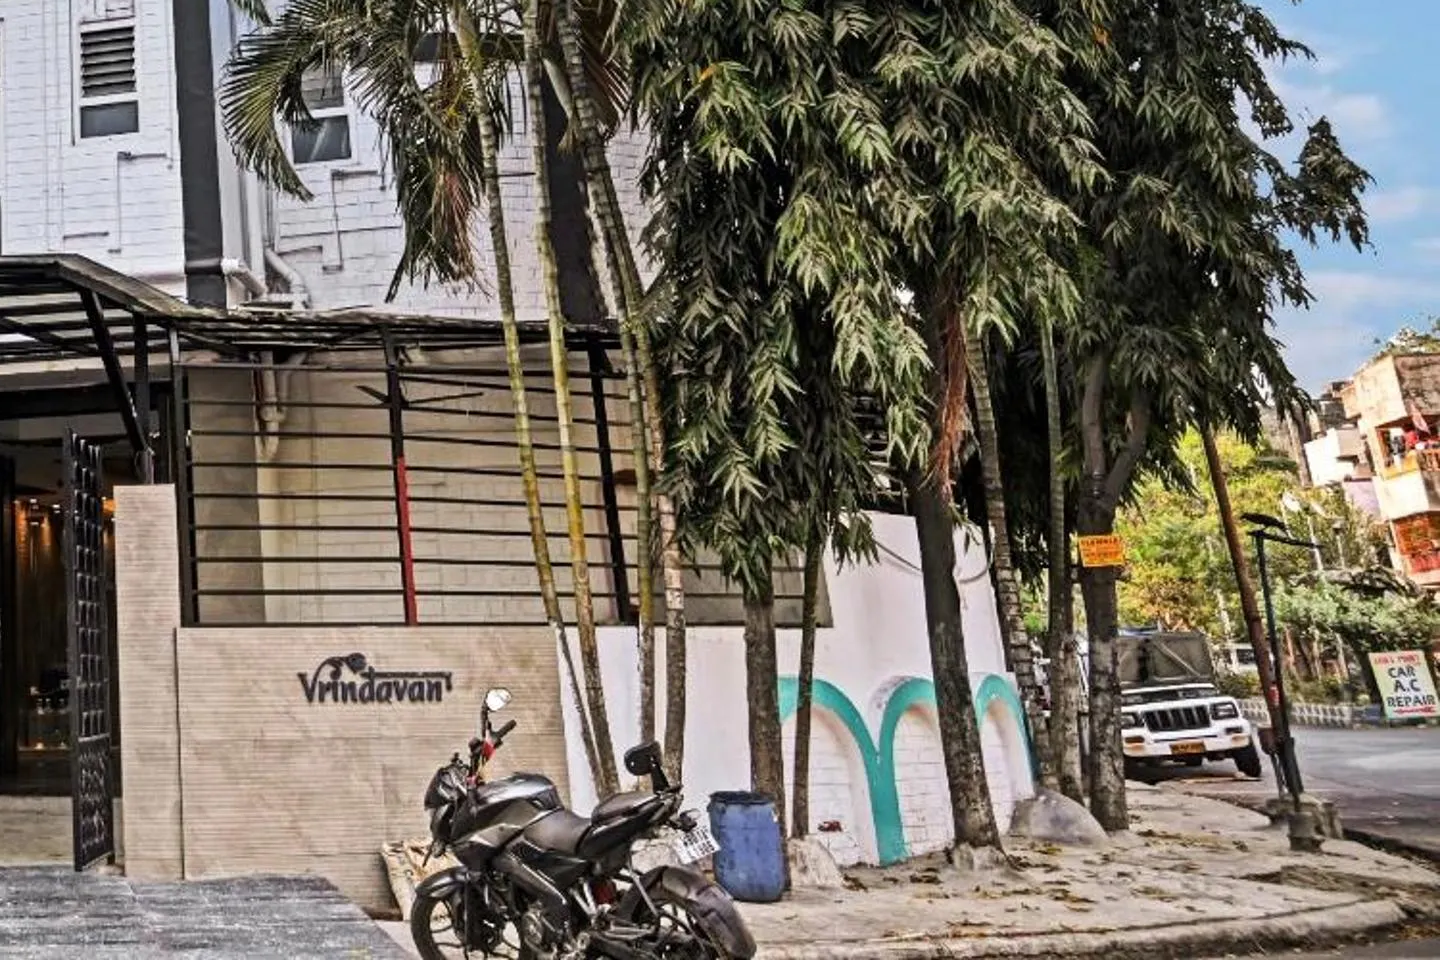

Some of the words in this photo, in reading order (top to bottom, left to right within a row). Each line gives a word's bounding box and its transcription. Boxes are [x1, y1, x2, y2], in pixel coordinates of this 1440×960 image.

[1388, 665, 1416, 679] CAR
[297, 655, 452, 704] Vrindavan
[1393, 679, 1421, 692] A.C
[1387, 695, 1436, 708] REPAIR
